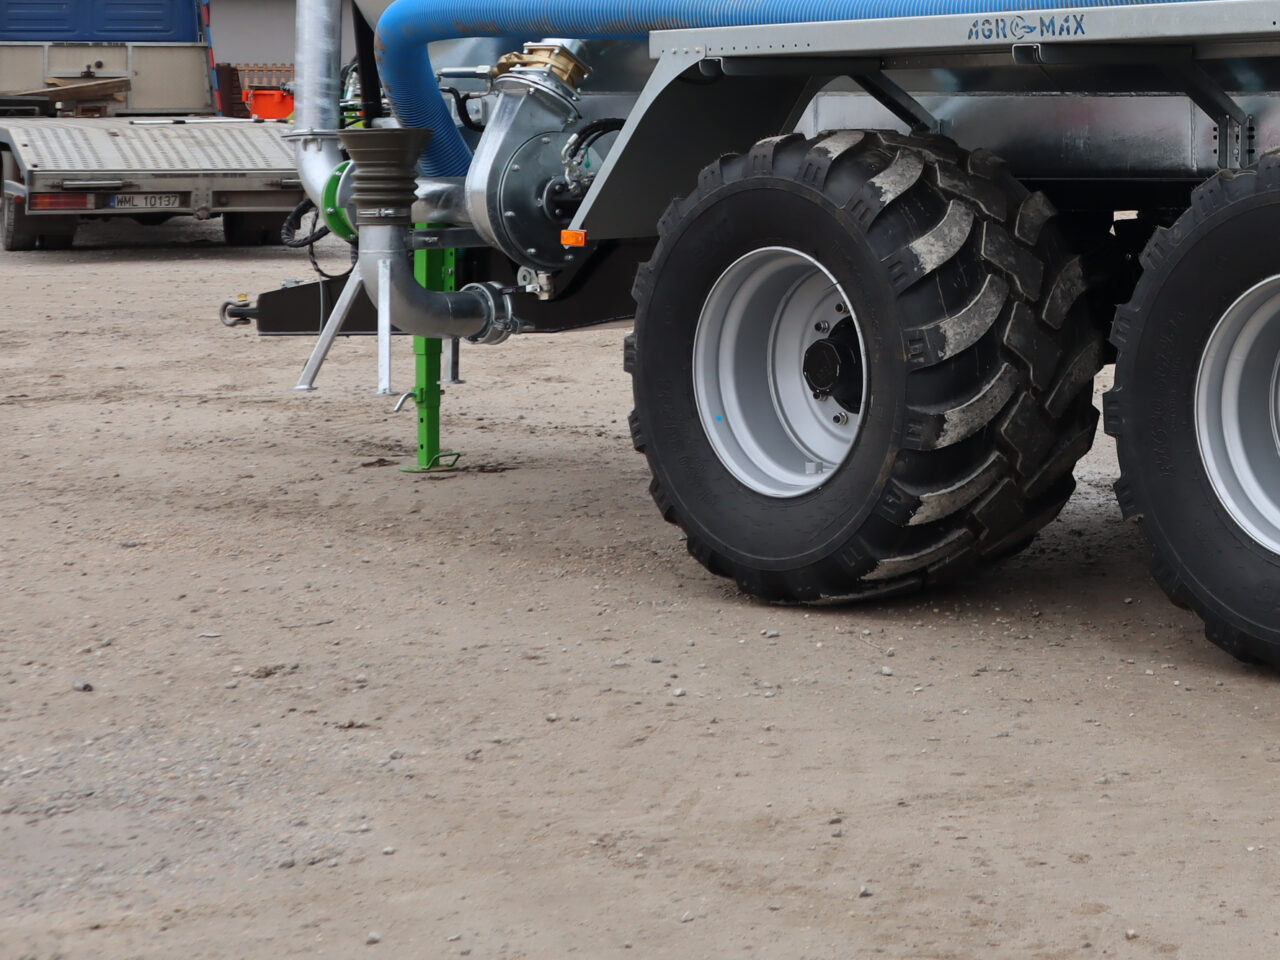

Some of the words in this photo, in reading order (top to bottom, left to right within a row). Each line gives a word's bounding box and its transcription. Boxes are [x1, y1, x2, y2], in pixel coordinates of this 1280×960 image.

[1040, 14, 1086, 37] MAX
[116, 195, 138, 207] WML
[144, 195, 178, 207] 10137
